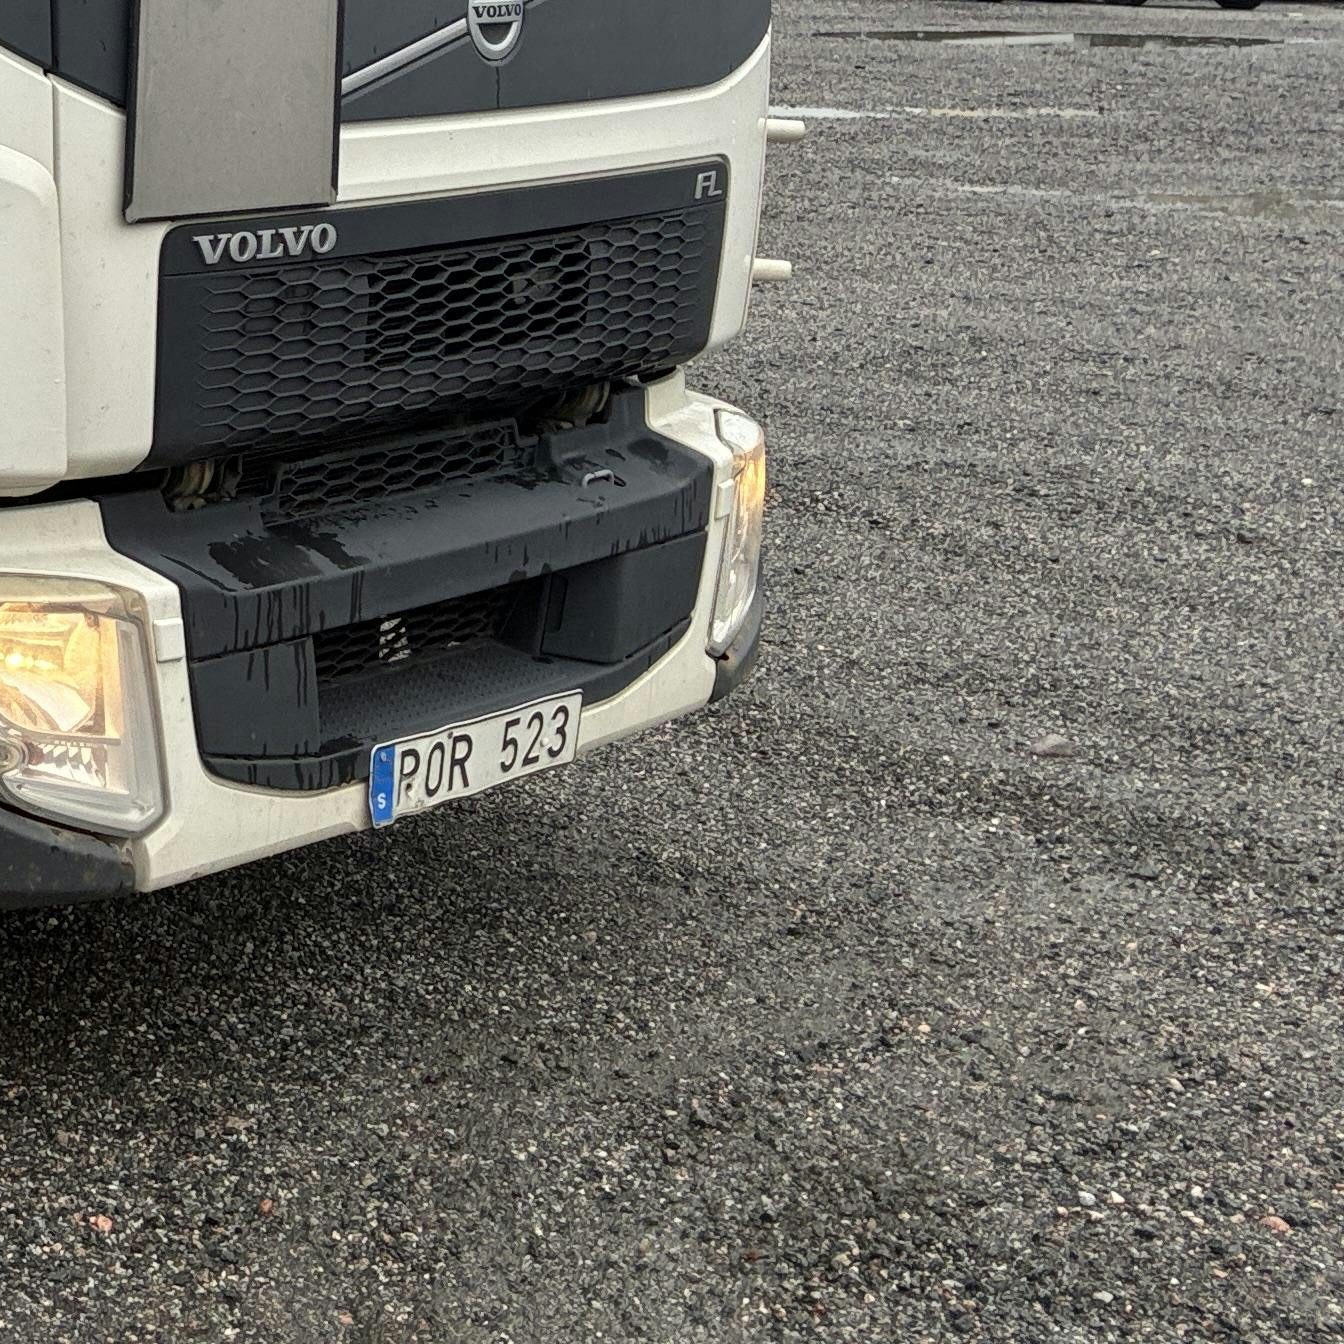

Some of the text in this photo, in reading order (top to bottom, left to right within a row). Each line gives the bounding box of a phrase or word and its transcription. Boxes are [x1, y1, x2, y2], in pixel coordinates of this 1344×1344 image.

[472, 3, 522, 18] VOLVO
[694, 170, 723, 199] FL
[192, 223, 337, 265] VOLVO
[377, 704, 570, 809] S POR 523
